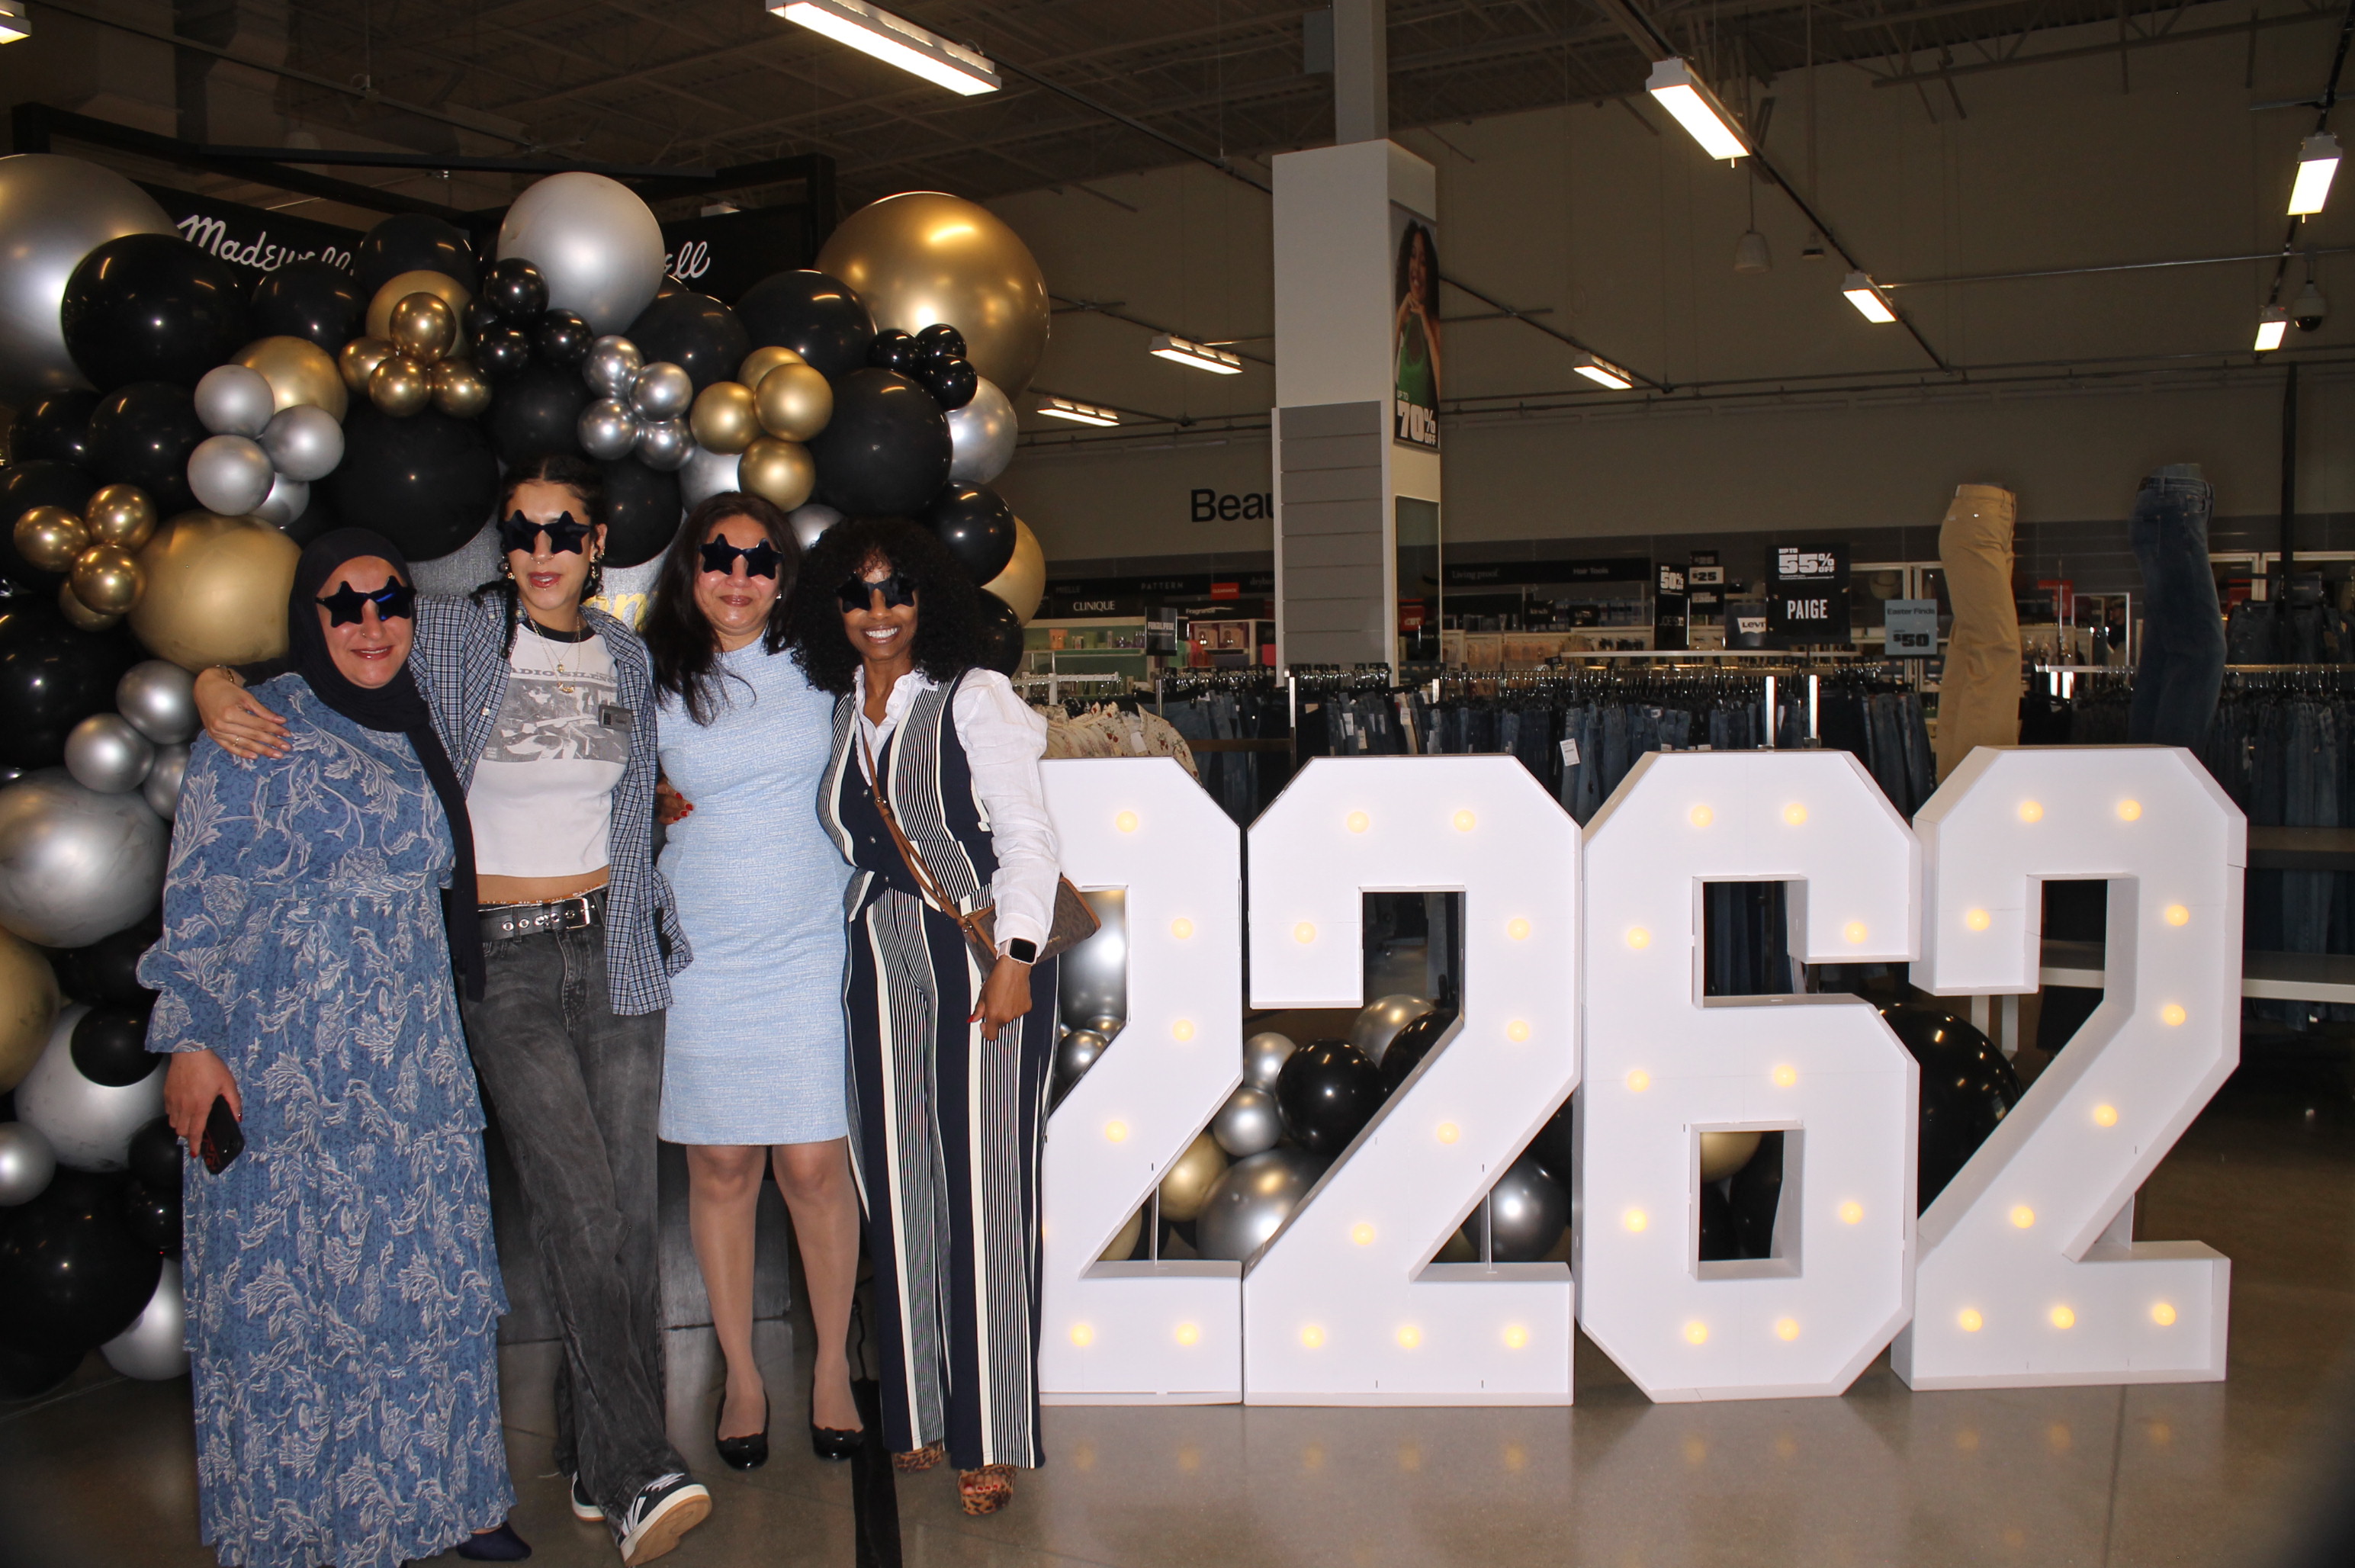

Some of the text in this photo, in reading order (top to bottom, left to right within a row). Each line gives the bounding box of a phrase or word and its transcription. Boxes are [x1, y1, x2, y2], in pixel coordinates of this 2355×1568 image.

[177, 215, 354, 275] Madew
[1397, 399, 1436, 442] 70%
[1778, 553, 1834, 574] 55%
[1073, 601, 1116, 612] CLINIQUE
[1787, 599, 1828, 619] PAIGE
